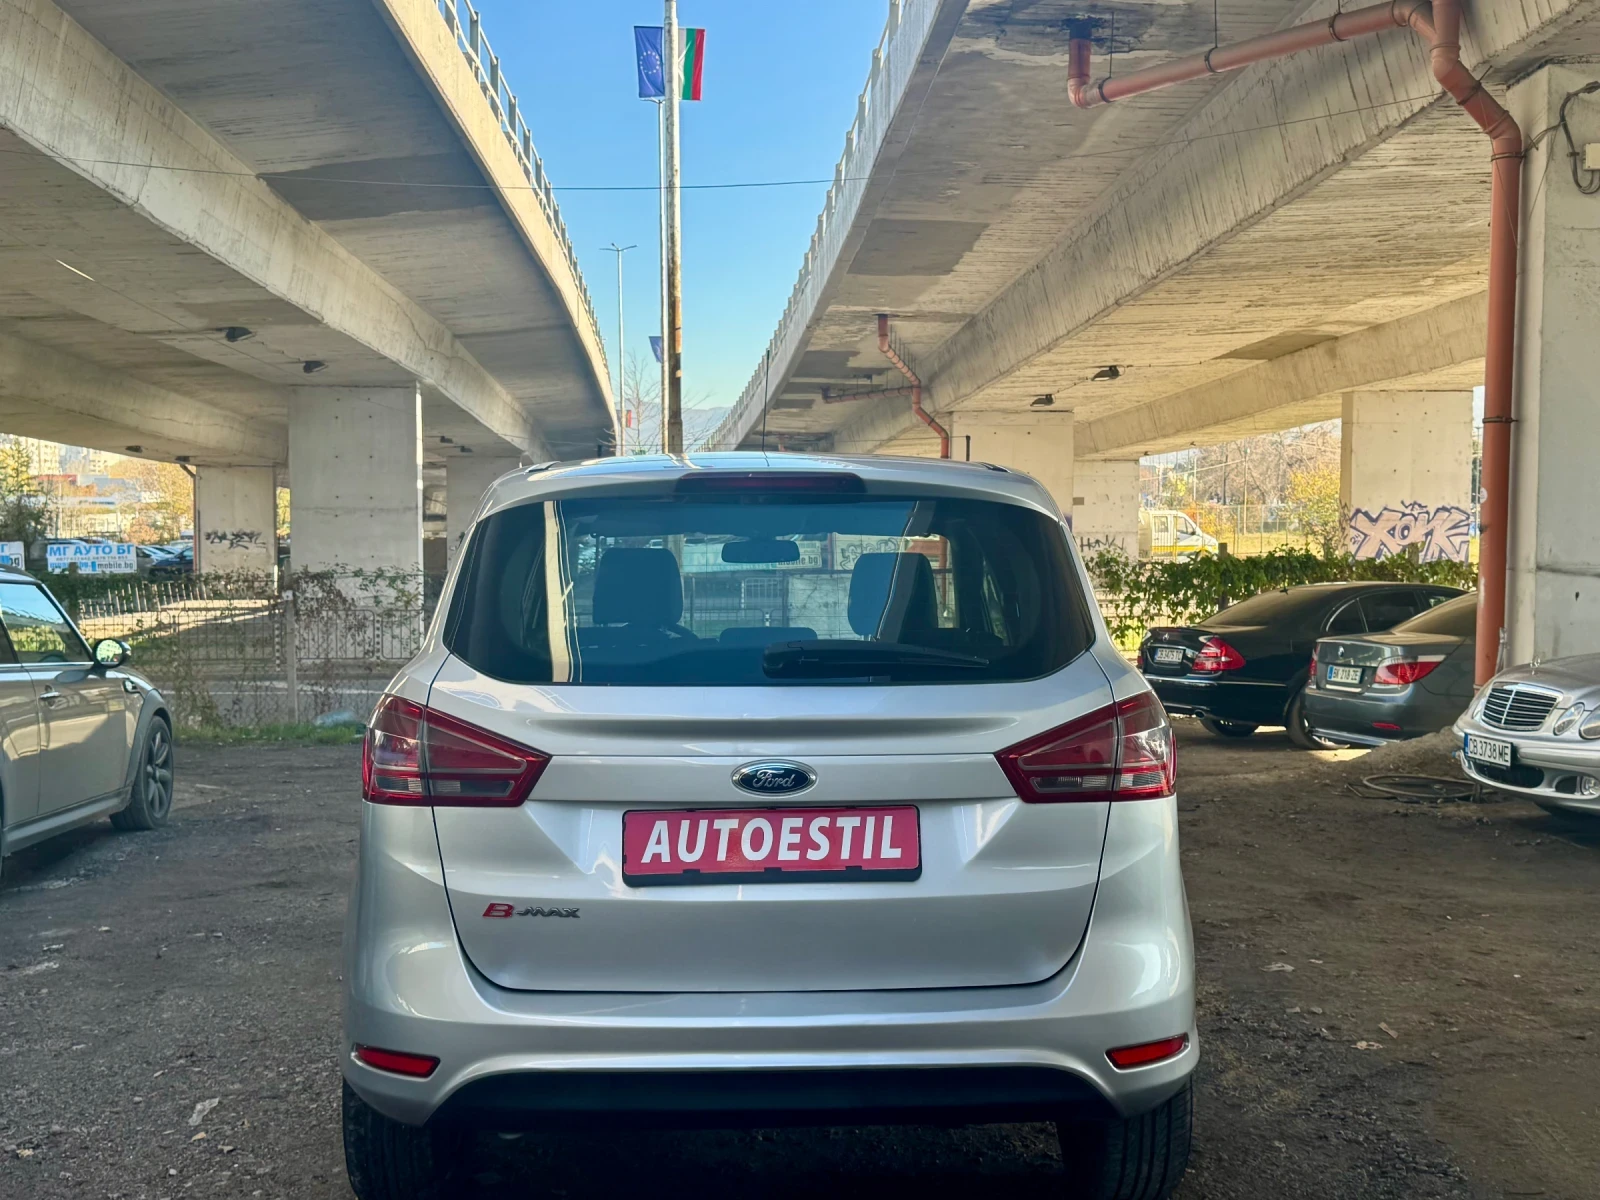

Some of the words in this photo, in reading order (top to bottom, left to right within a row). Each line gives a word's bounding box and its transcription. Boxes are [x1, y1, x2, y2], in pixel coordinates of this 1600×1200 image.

[49, 546, 69, 556] МГ
[74, 545, 113, 556] АУТО
[117, 544, 134, 555] БГ
[97, 561, 134, 570] mobile.bg
[1469, 738, 1478, 755] CB
[1479, 740, 1497, 760] 3738
[1498, 744, 1509, 763] ME
[752, 769, 795, 788] Ford
[641, 816, 902, 863] AUTOESTIL
[482, 902, 581, 919] B-MAX
